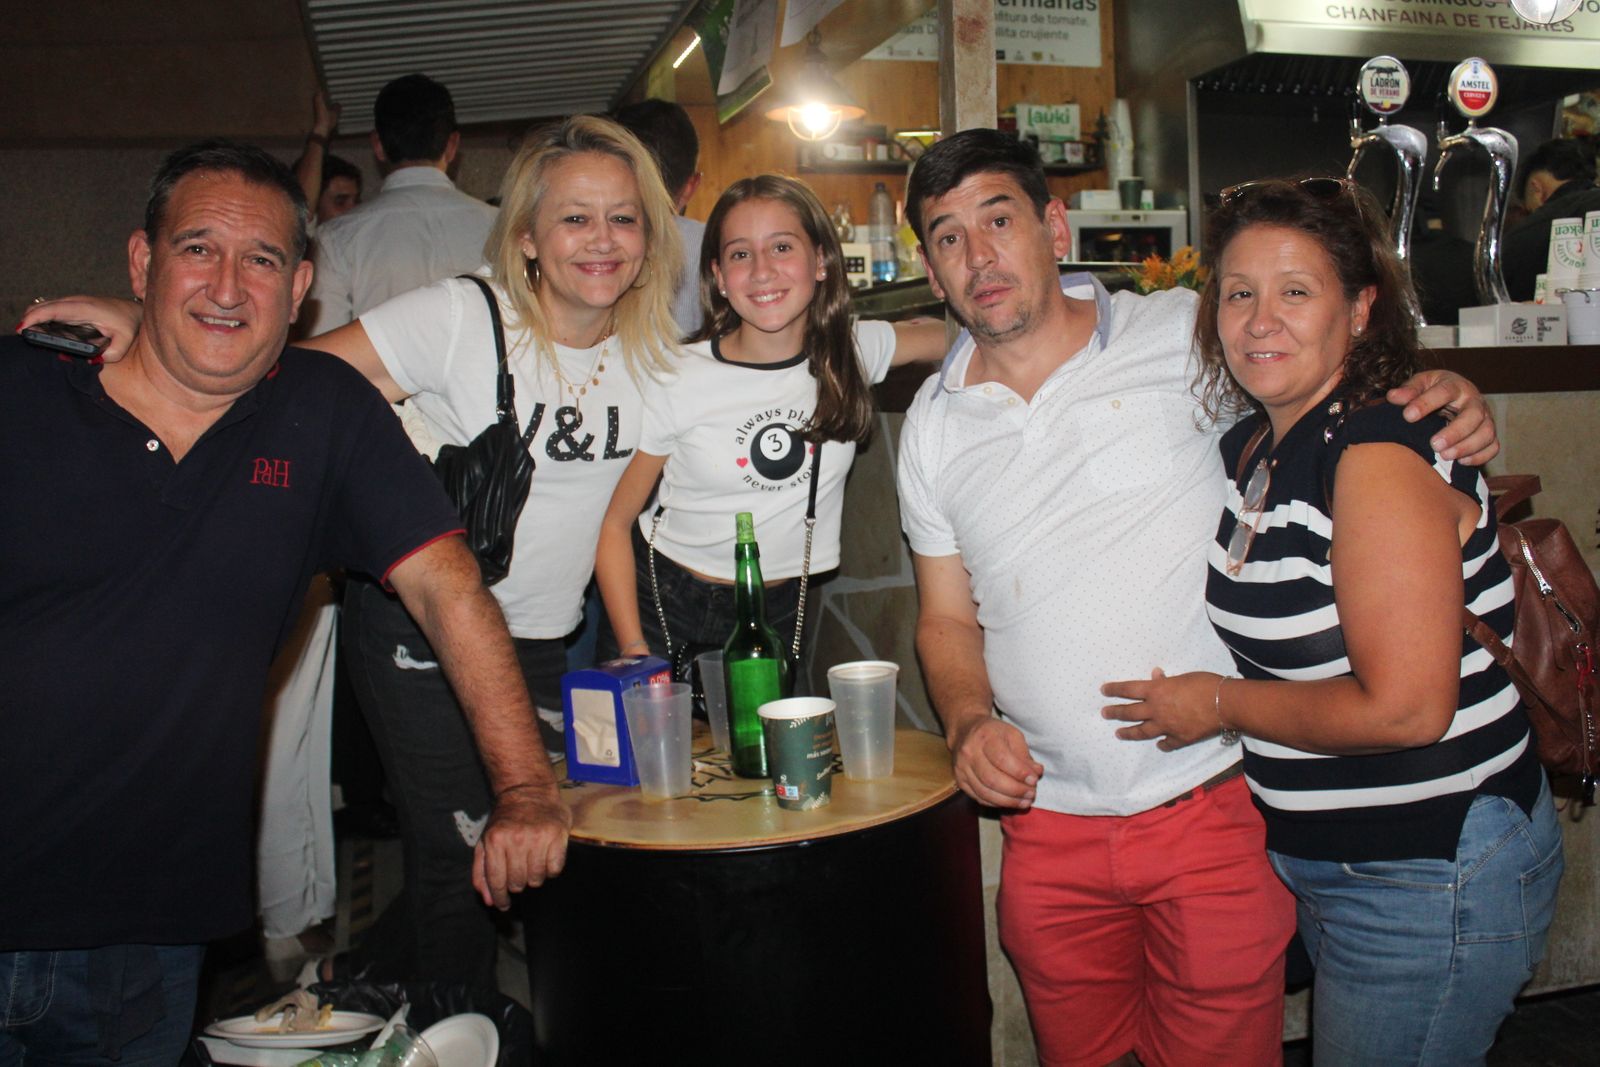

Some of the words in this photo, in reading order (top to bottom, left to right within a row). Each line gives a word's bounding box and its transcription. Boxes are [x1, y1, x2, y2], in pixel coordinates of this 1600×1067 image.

[995, 0, 1097, 11] ermanas
[1030, 13, 1045, 24] de
[1326, 5, 1449, 26] CHANFAINA
[1453, 13, 1481, 29] DE
[1460, 80, 1491, 90] AMSTEL
[1554, 224, 1583, 237] eken
[735, 407, 782, 445] always
[788, 408, 812, 428] pla
[767, 433, 783, 453] 3
[742, 474, 784, 492] never
